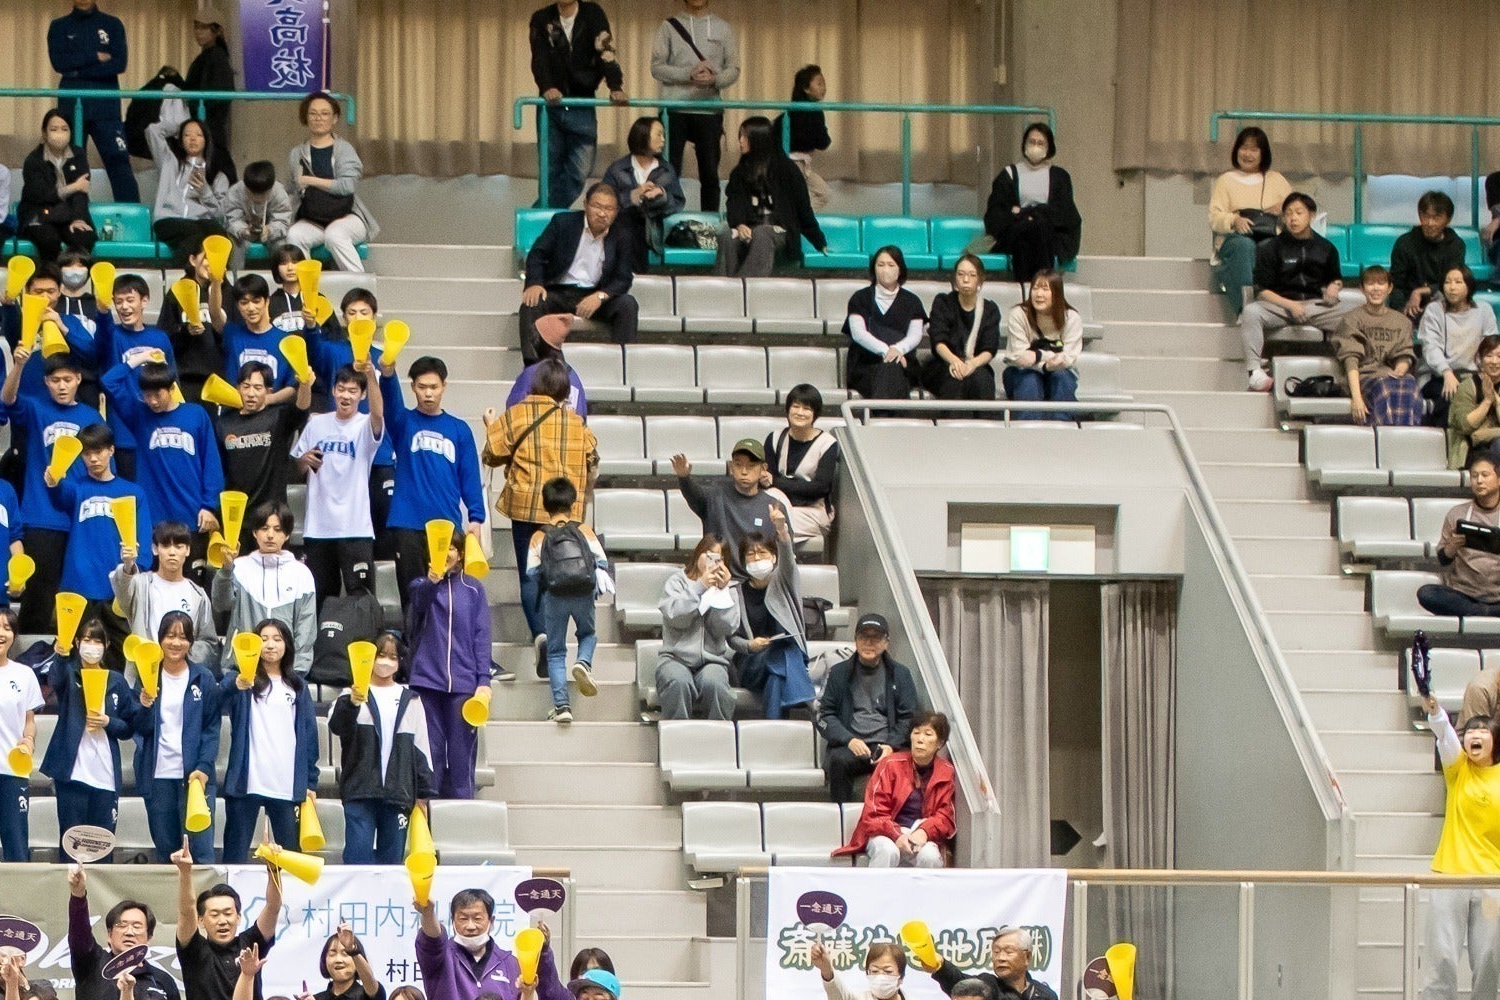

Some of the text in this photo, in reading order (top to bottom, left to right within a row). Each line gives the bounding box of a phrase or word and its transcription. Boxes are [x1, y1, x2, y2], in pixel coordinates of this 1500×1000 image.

[518, 888, 562, 901] 一念通天
[800, 901, 844, 916] 一念通天
